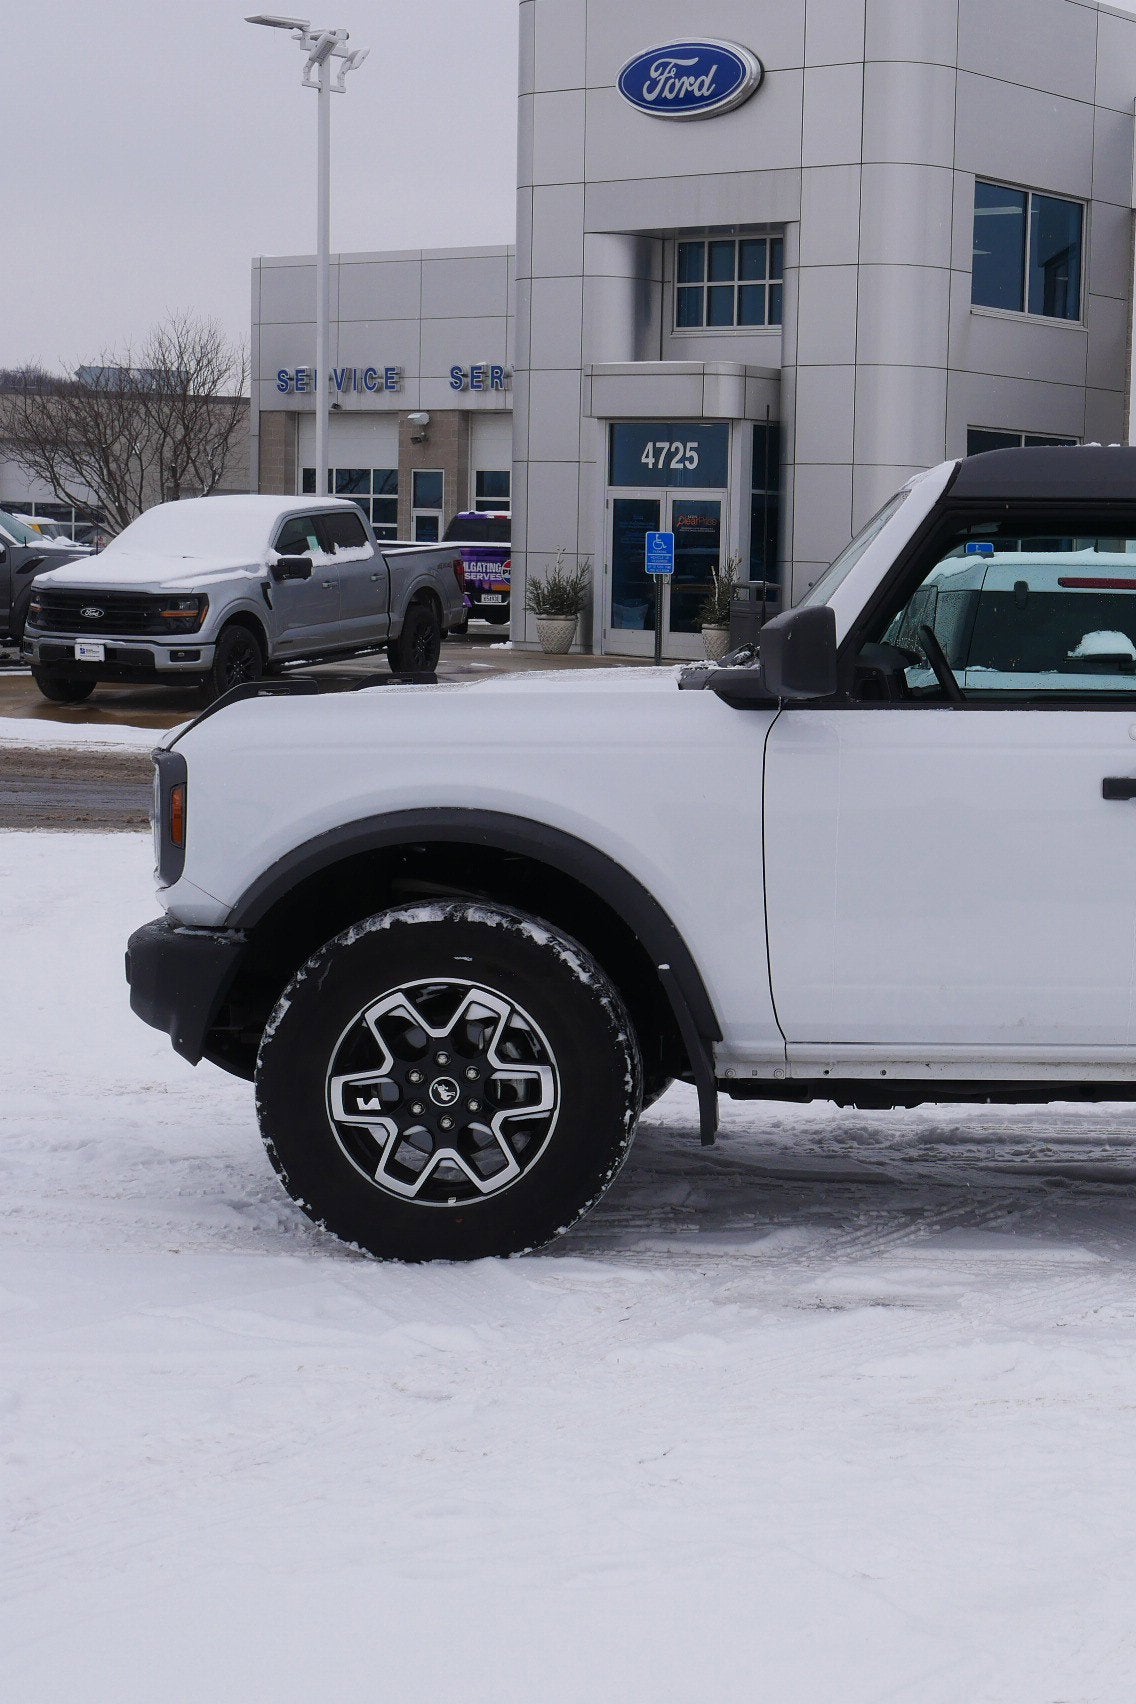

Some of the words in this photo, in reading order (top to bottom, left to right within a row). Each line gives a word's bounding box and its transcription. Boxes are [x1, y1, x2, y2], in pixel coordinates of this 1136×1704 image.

[642, 57, 718, 101] Ford
[276, 367, 398, 393] SEVICE
[641, 441, 699, 470] 4725
